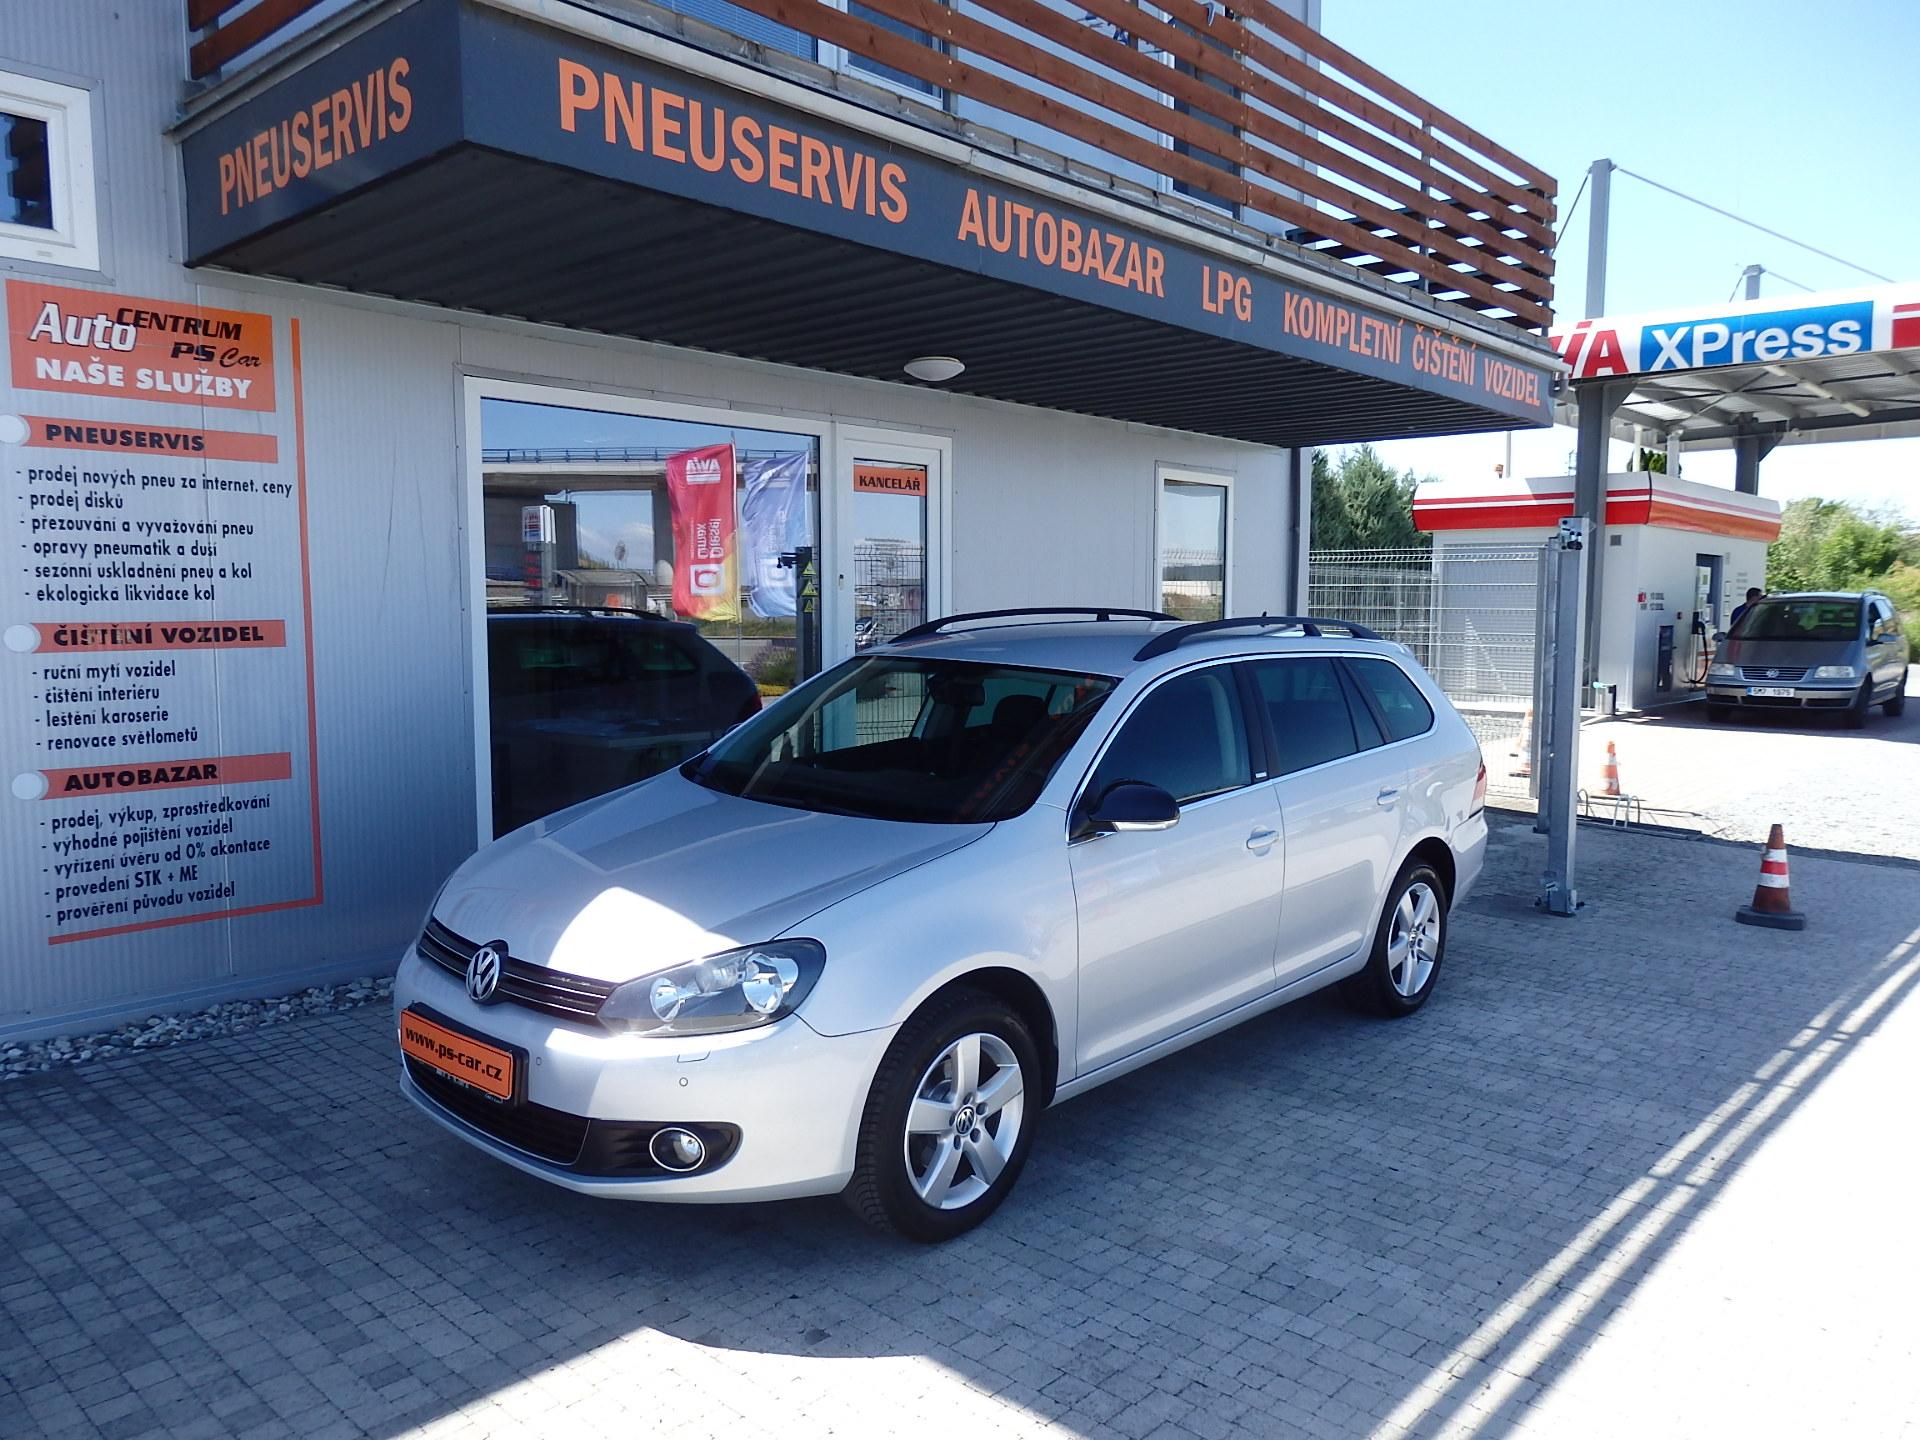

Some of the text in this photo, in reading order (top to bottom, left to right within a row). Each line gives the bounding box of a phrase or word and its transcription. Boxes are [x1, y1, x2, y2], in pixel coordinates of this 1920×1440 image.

[219, 57, 412, 215] PNEUSERVIS
[558, 57, 1541, 407] PNEUSERVIS AUTOBAZAR LPG KOMPLETNÍ ČIŠTĚNÍ VOZIDEL
[27, 300, 243, 352] Auto CENTRUM
[171, 341, 262, 369] PS Car
[1650, 318, 1863, 372] XPress
[35, 356, 253, 399] NAŠE SLUŽBY
[46, 423, 206, 451] PNEUSERVIS
[28, 464, 293, 498] prodej nových pneu za internet. ceny
[859, 475, 921, 491] KANCELÁŘ
[30, 488, 124, 512] prodej disků
[32, 514, 254, 539] přezouvání a vyvažování pneu
[33, 539, 217, 559] opravy pneumatik a duší
[35, 561, 252, 582] sezónní uskladnění pneu a kol
[36, 584, 215, 606] ekologická likvidace kol
[53, 623, 264, 646] ČIŠTĚNÍ VOZIDEL
[44, 659, 176, 683] ruční mytí vozidel
[45, 683, 160, 704] čištění interiéru
[46, 705, 169, 727] leštění karoserie
[48, 726, 198, 750] renovace světlometů
[64, 763, 218, 792] AUTOBAZAR
[52, 793, 271, 834] prodej, výkup, zprostředkování
[53, 817, 233, 856] výhodné pojištění vozidel
[54, 838, 271, 879] vyřízení úvěru od 0% akontace
[55, 875, 130, 903] provedení
[134, 869, 161, 888] STK
[179, 865, 199, 882] ME
[57, 880, 235, 925] prověření původu vozidel
[405, 1026, 503, 1082] www.ps-car.cz
